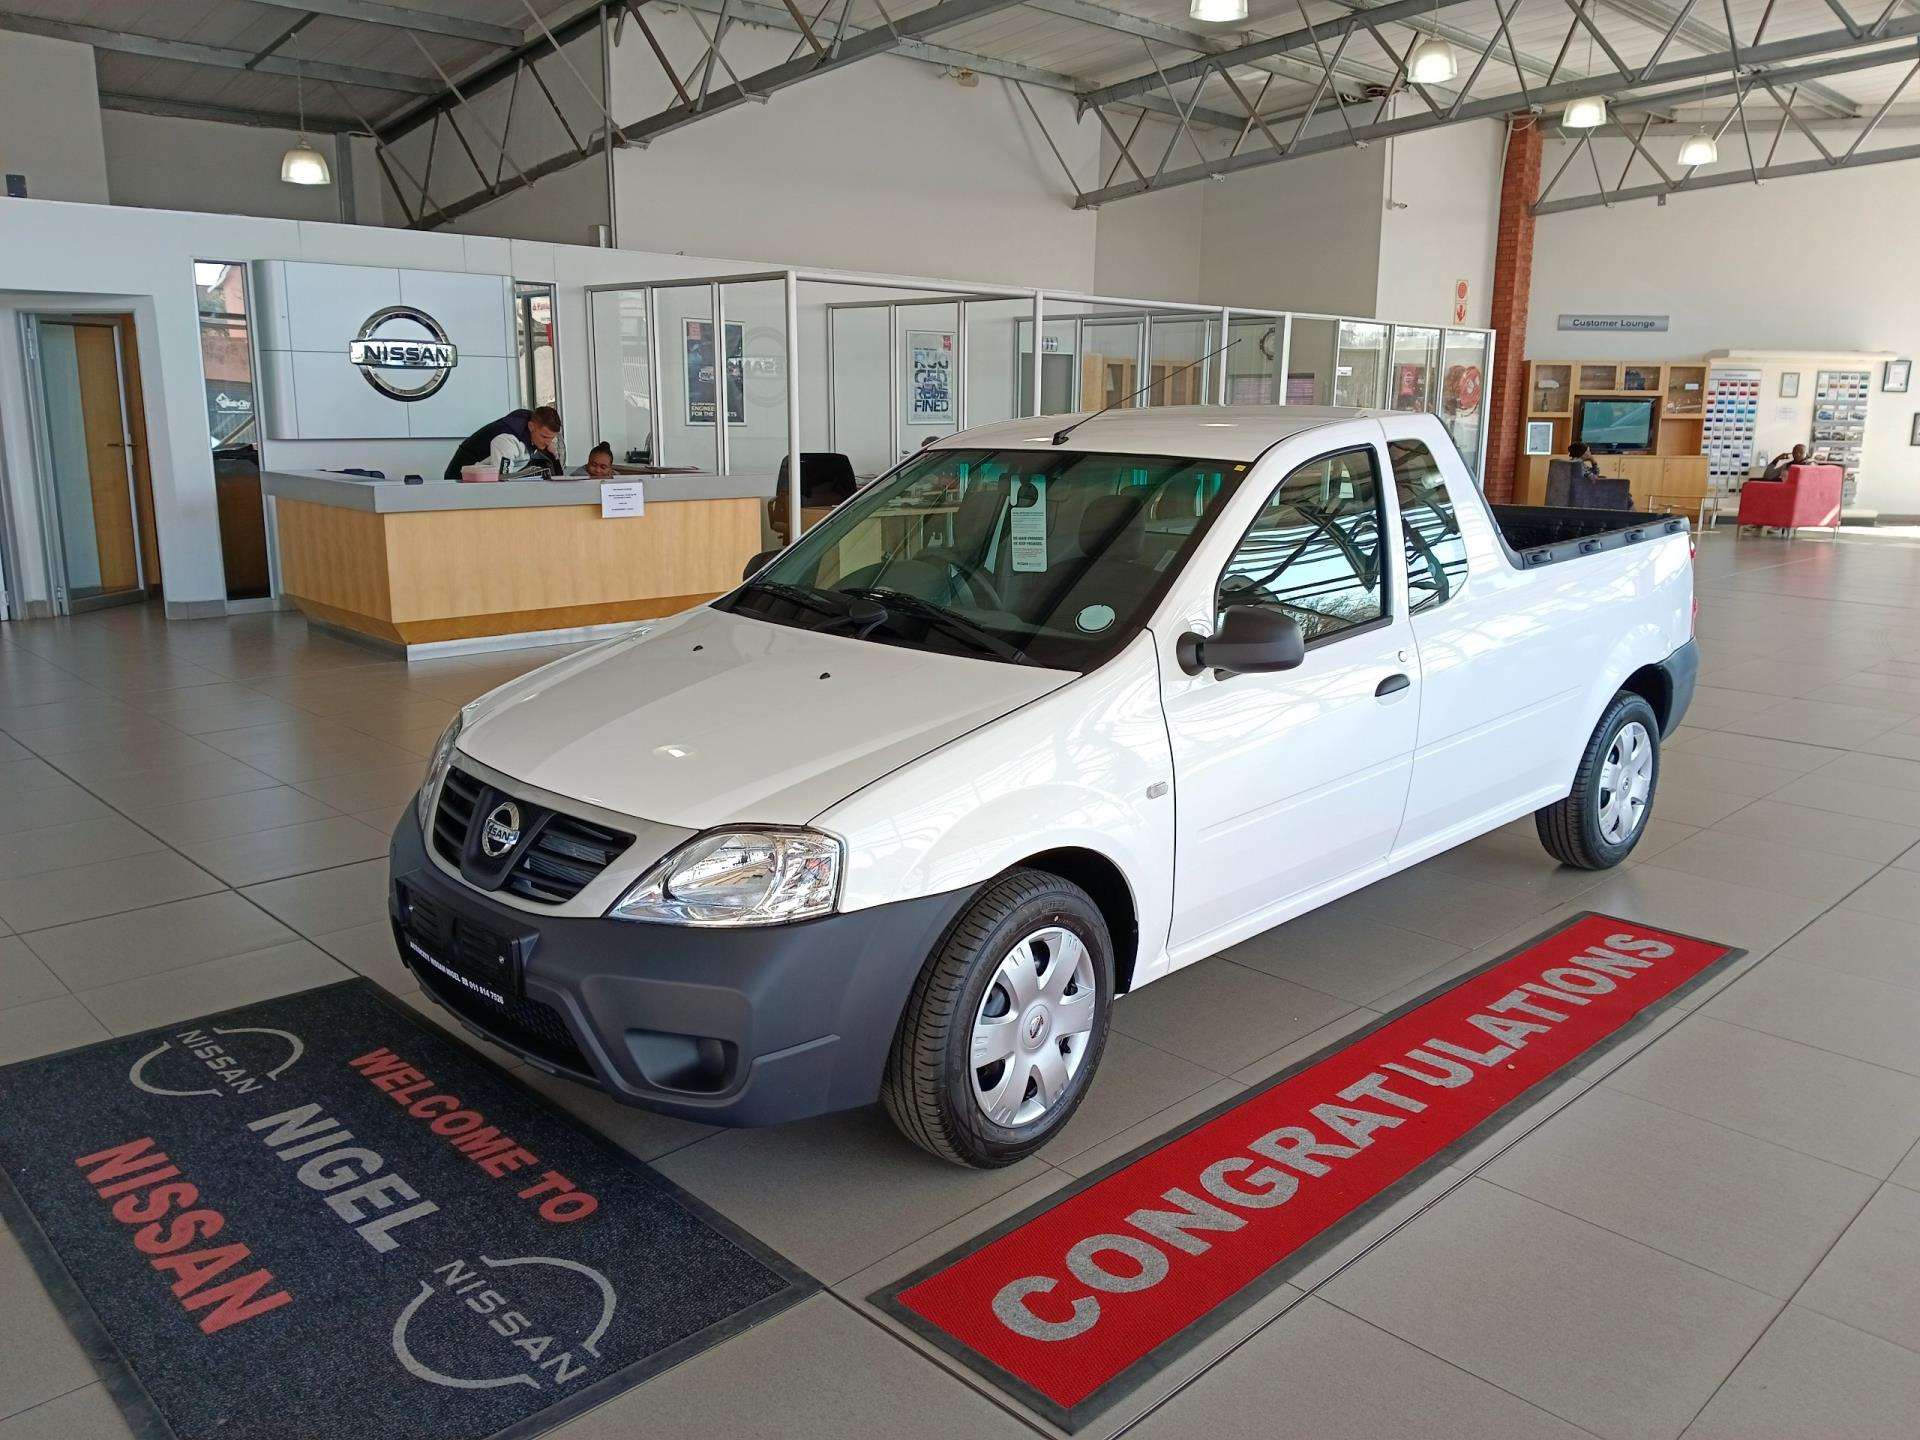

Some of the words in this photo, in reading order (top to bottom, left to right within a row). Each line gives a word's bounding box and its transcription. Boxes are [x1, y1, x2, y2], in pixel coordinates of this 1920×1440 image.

[363, 344, 449, 363] NISSAN
[1572, 318, 1618, 328] Customer
[1620, 319, 1656, 329] Lounge
[914, 400, 949, 412] FINED
[176, 1029, 263, 1095] NISSAN
[246, 1102, 440, 1253] NIGEL
[349, 1047, 539, 1178] WELCOME
[517, 1170, 598, 1222] TO
[991, 932, 1676, 1343] CONGRATULATIONS
[75, 1136, 294, 1334] NISSAN
[433, 1259, 587, 1385] NISSAN
